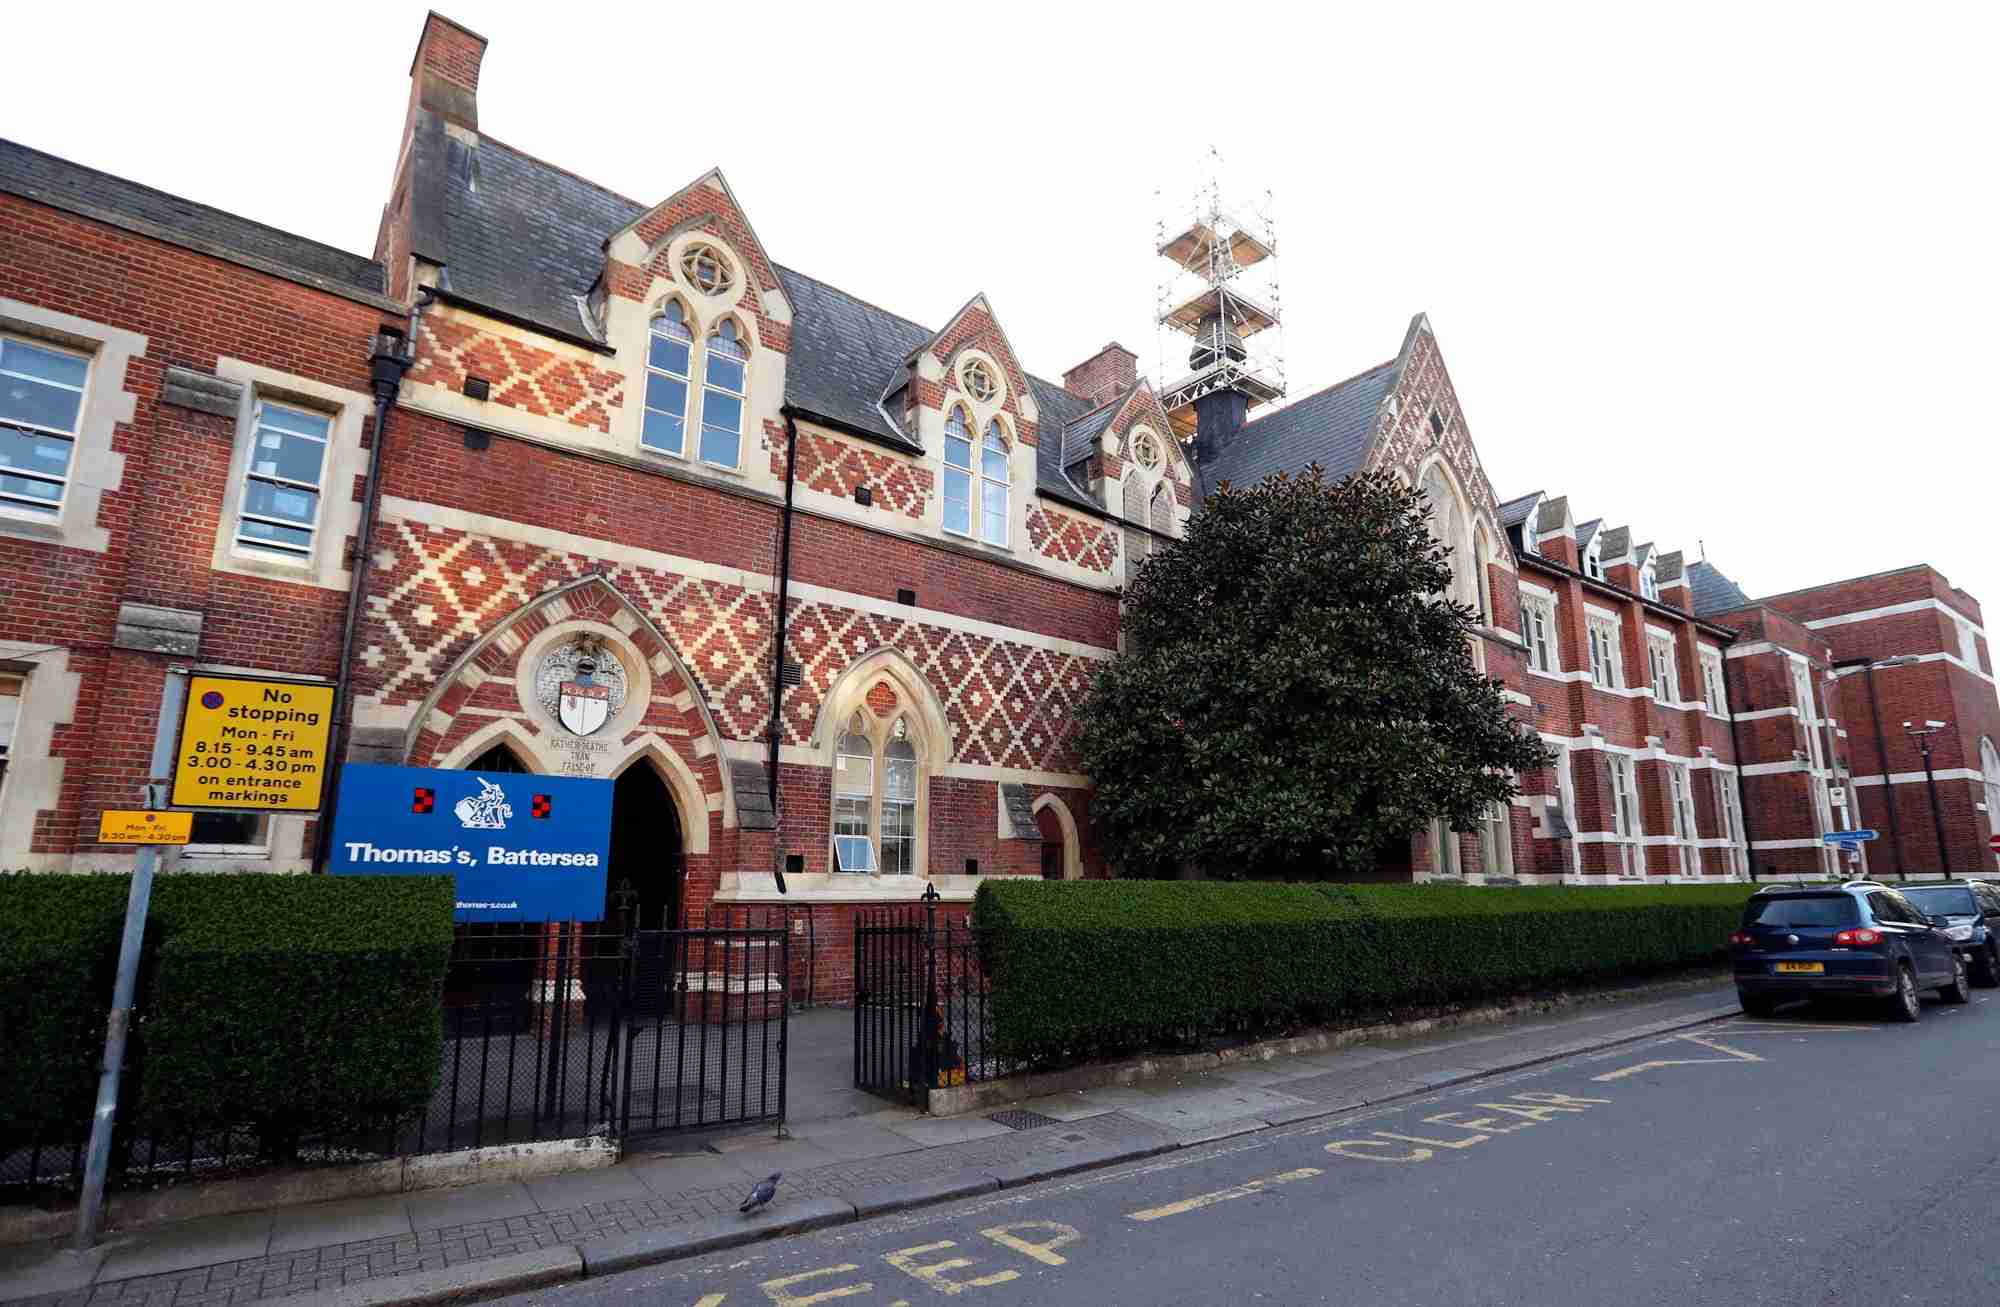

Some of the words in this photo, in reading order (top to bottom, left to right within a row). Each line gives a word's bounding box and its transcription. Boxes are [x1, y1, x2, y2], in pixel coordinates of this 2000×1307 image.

[263, 688, 292, 704] No
[228, 705, 319, 726] stopping
[222, 726, 257, 739] Mon
[272, 729, 295, 741] Fri
[195, 741, 232, 754] 8.15
[246, 744, 286, 757] 9.45
[289, 749, 313, 759] am
[187, 755, 232, 769] 3.00
[245, 759, 288, 772] 4.30
[291, 762, 316, 773] pm
[198, 775, 219, 785] on
[226, 776, 302, 789] entrance
[208, 790, 289, 804] markings
[345, 842, 478, 868] Thomas's,
[487, 846, 599, 868] Battersea
[1324, 1091, 1613, 1162] CLEAR
[693, 1219, 1081, 1307] EEP
